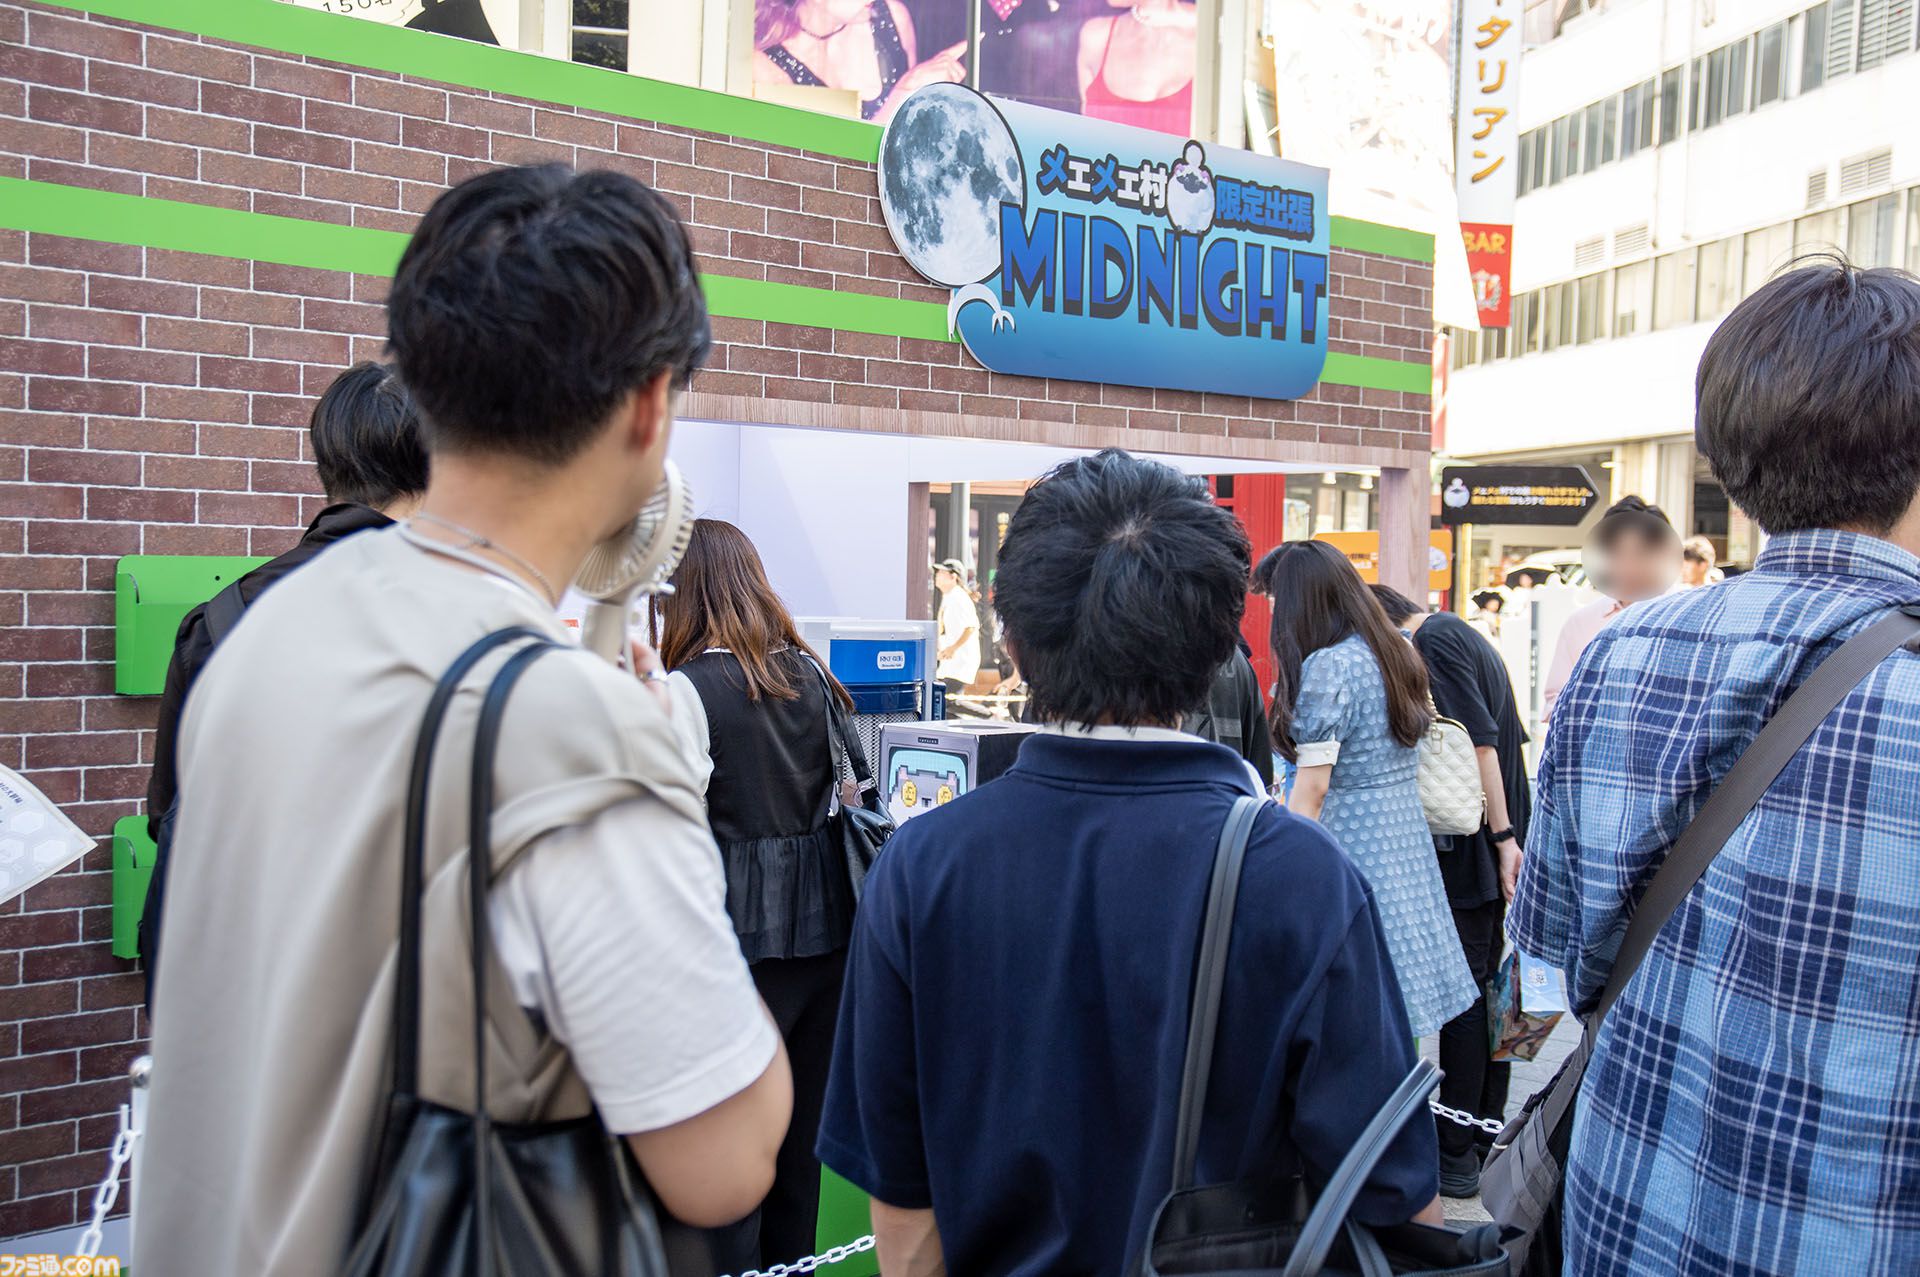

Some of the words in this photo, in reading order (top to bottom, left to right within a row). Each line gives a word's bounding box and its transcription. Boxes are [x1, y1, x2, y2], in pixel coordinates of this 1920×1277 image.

[1471, 0, 1511, 184] タリアン
[1214, 178, 1314, 236] 限定出張
[1463, 231, 1506, 255] BAR
[1000, 201, 1327, 344] MIDNIGHT
